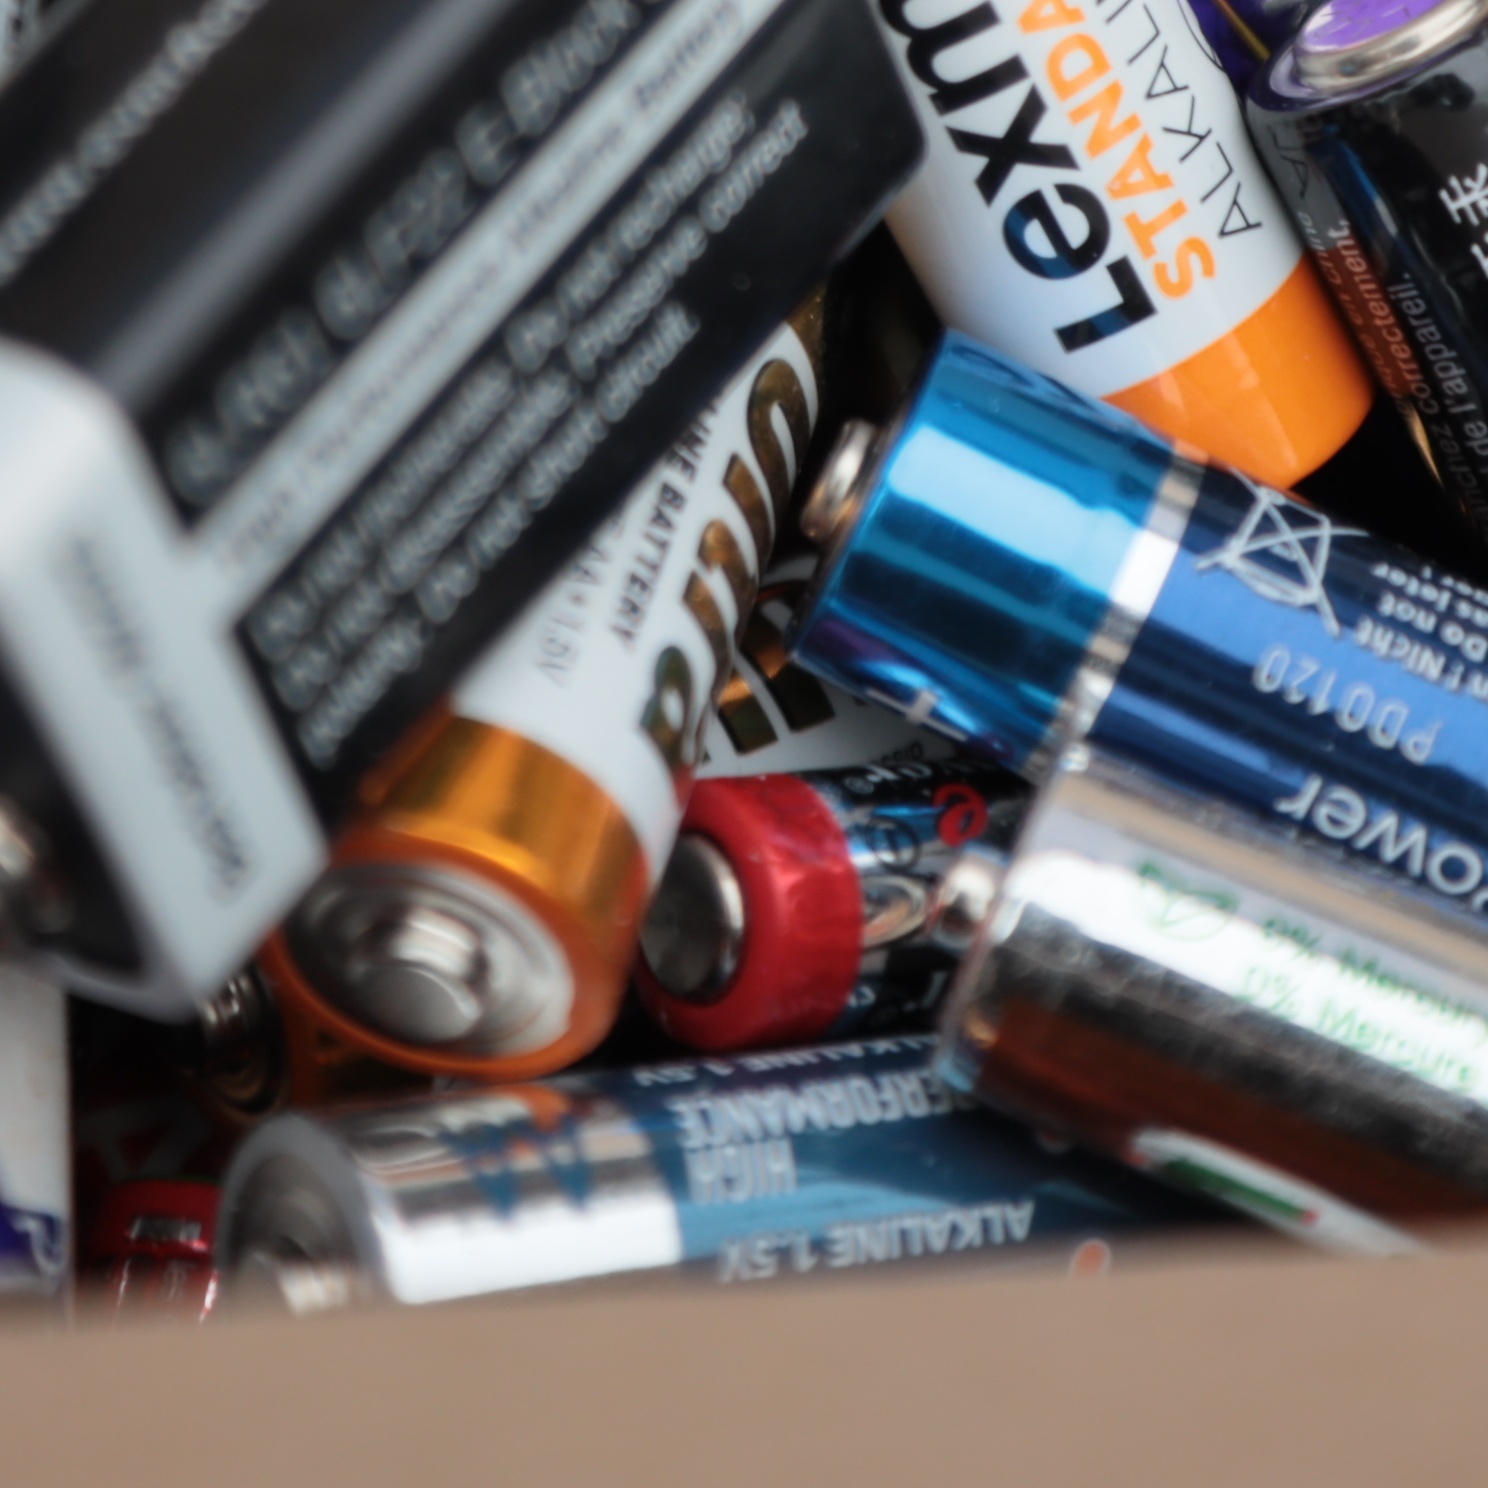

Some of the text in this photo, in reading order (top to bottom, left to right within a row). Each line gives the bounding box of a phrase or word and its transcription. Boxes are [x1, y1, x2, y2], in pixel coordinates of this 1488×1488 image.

[1318, 214, 1447, 416] correctement,
[608, 469, 694, 654] BATTERY
[1374, 586, 1436, 634] not
[1349, 612, 1449, 682] Nicht
[686, 1136, 796, 1205] HIGH
[823, 1197, 1035, 1268] ALKALINE
